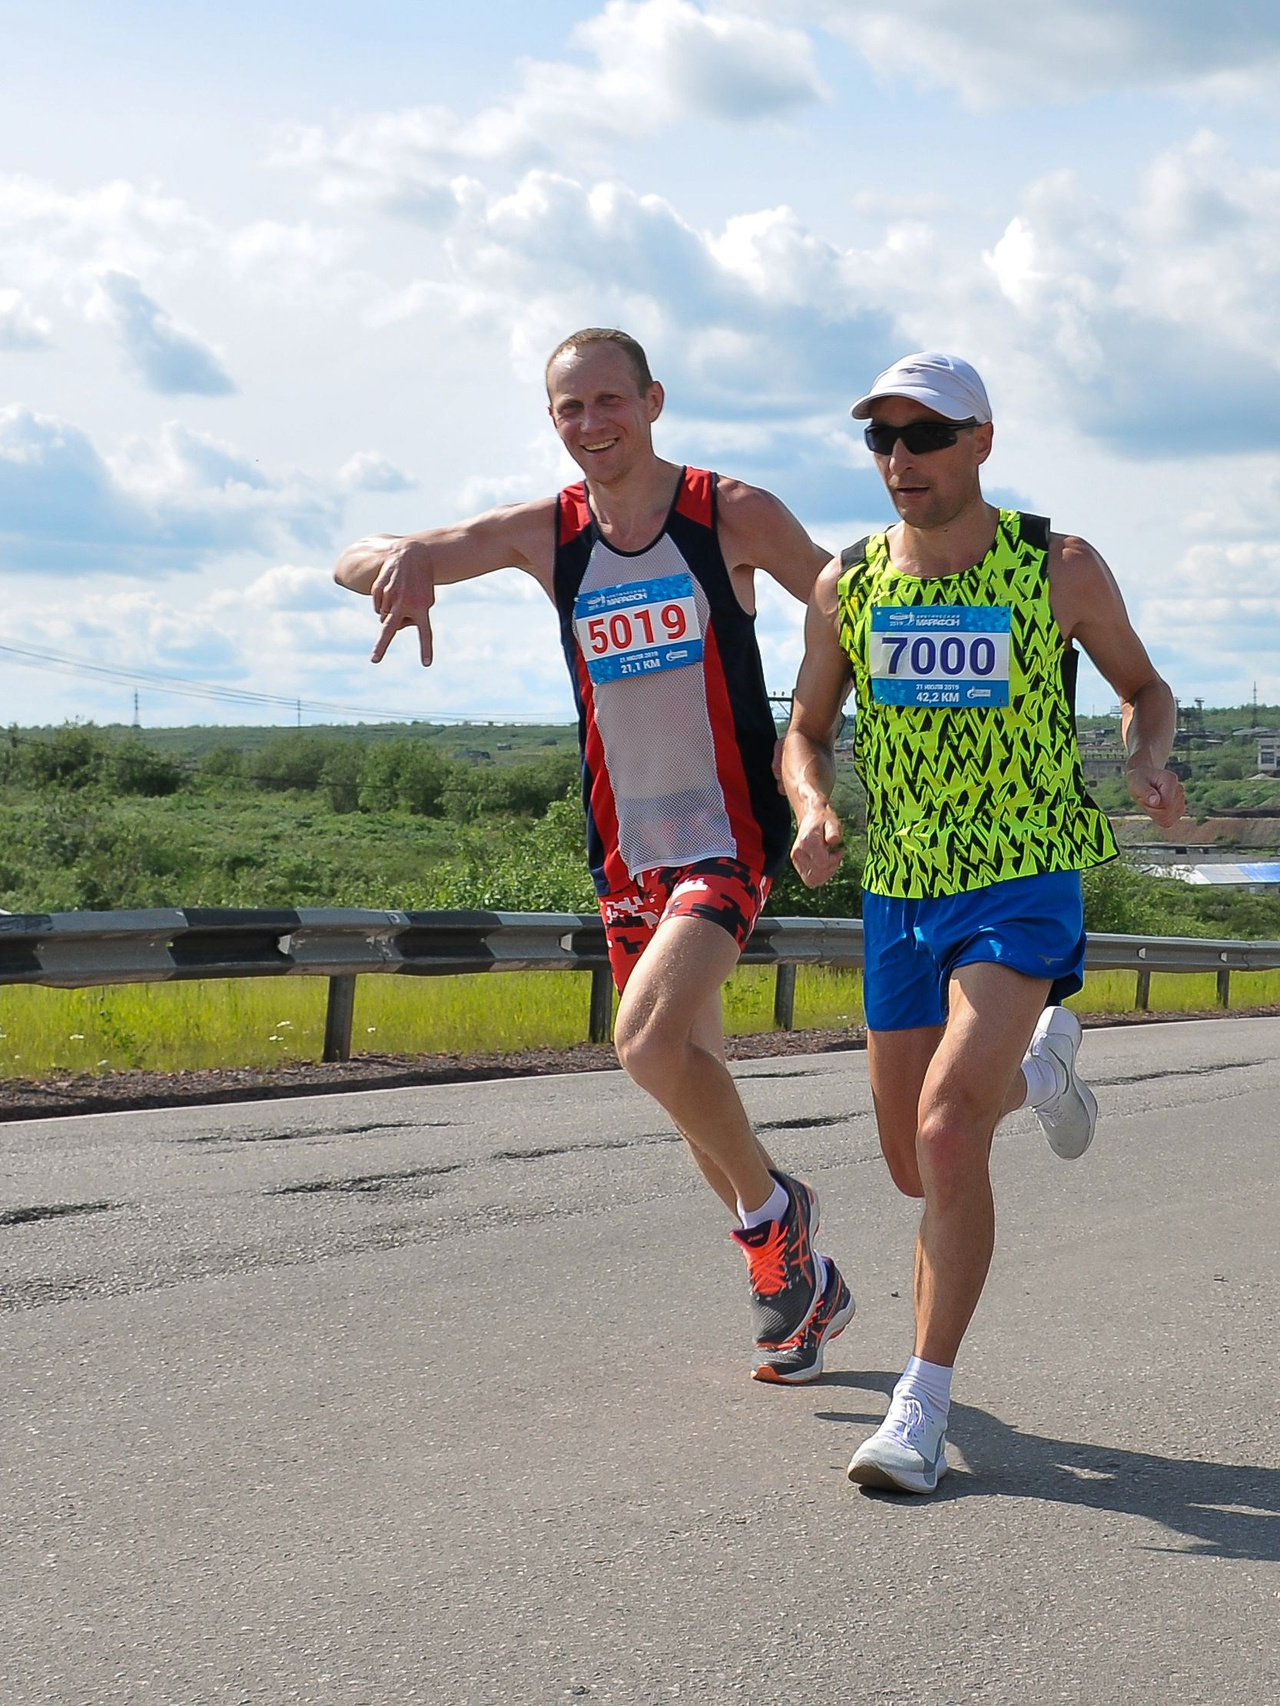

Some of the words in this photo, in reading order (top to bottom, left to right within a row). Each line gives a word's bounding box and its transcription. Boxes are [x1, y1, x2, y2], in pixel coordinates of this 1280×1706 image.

[587, 604, 687, 655] 5019
[620, 662, 642, 674] 21,1
[881, 636, 996, 676] 7000
[916, 692, 940, 704] 42,2
